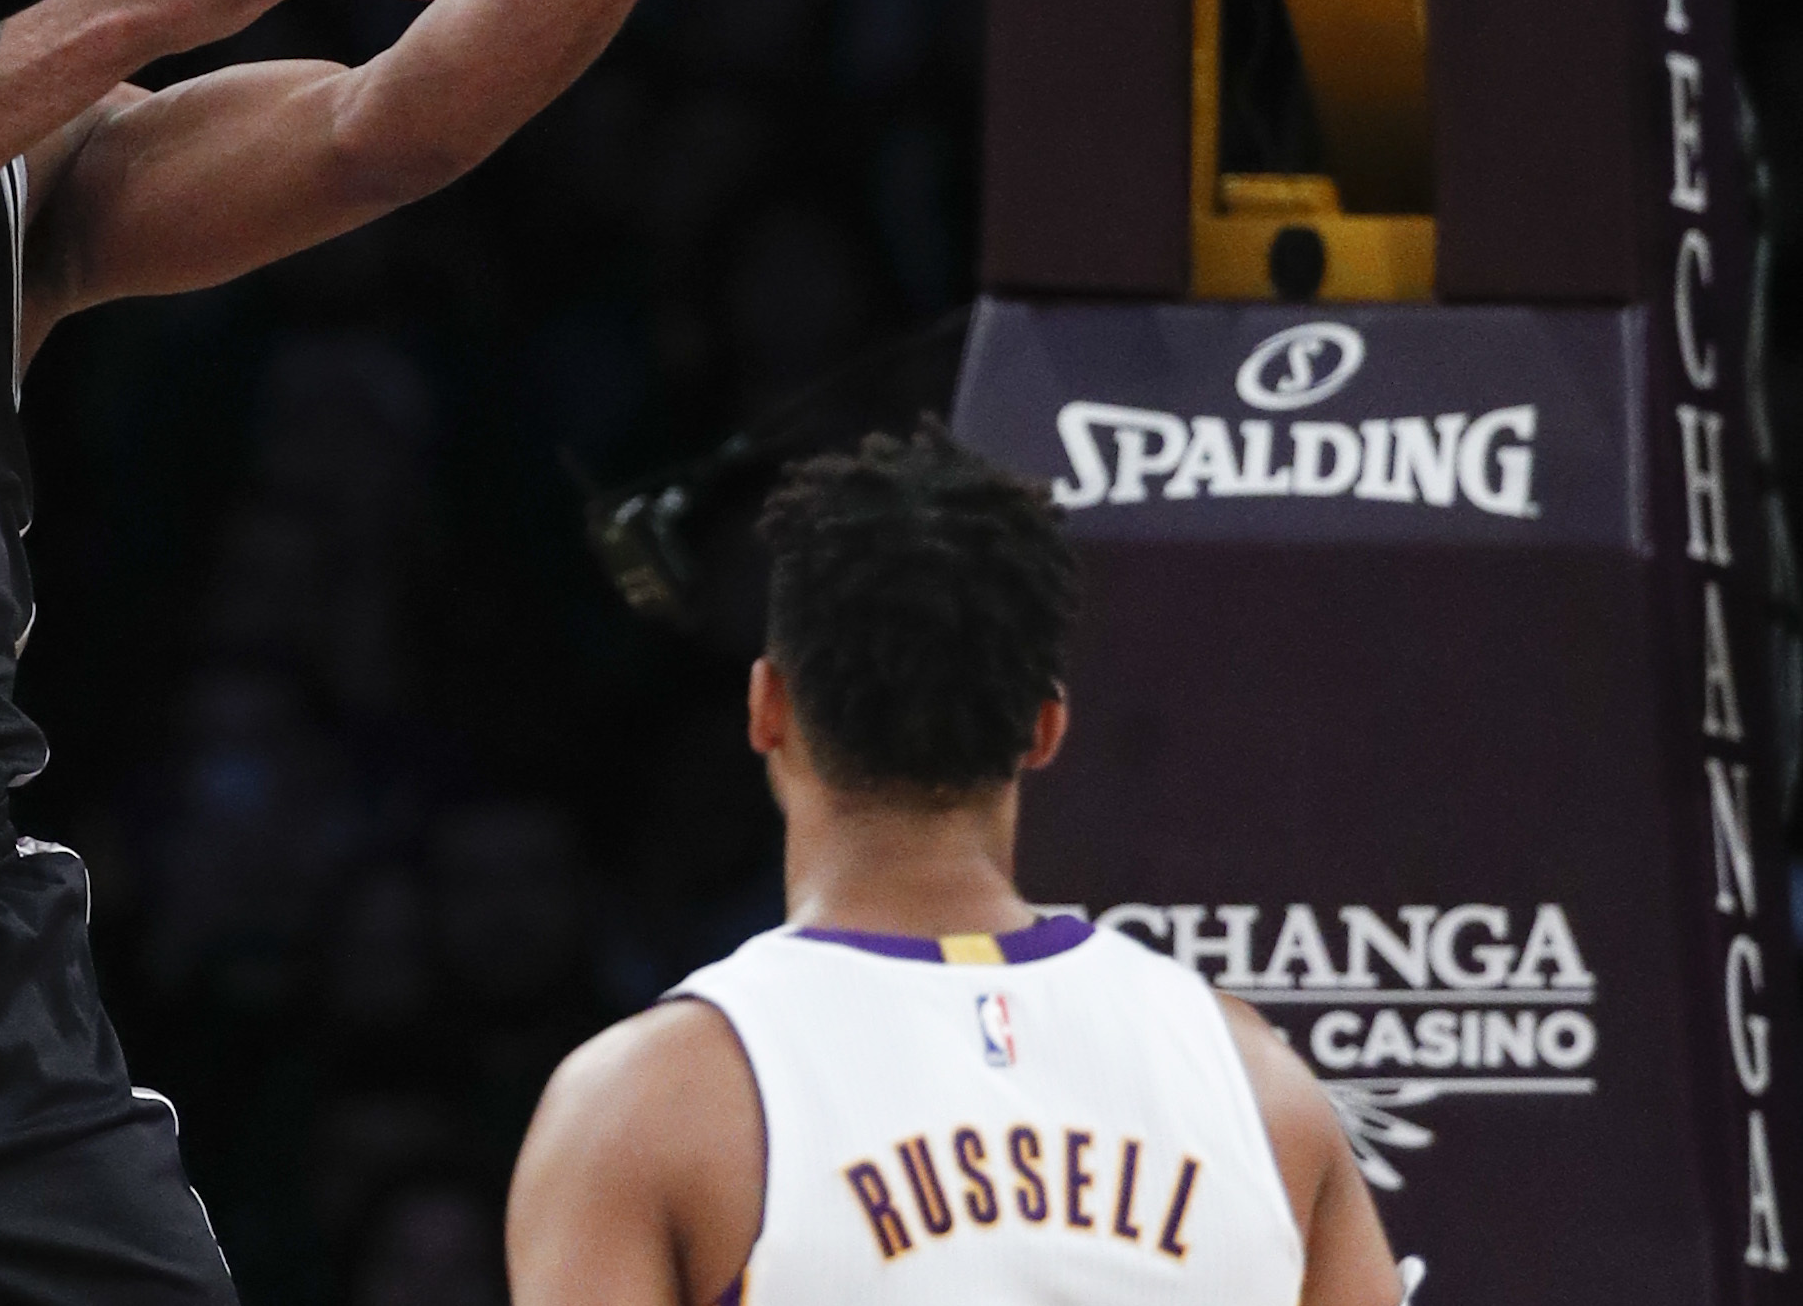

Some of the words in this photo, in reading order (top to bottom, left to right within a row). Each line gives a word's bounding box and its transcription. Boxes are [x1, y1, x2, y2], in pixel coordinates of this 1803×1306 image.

[1052, 400, 1538, 518] SPALDING
[1309, 1009, 1597, 1069] CASINO
[842, 1125, 1201, 1263] RUSSELL
